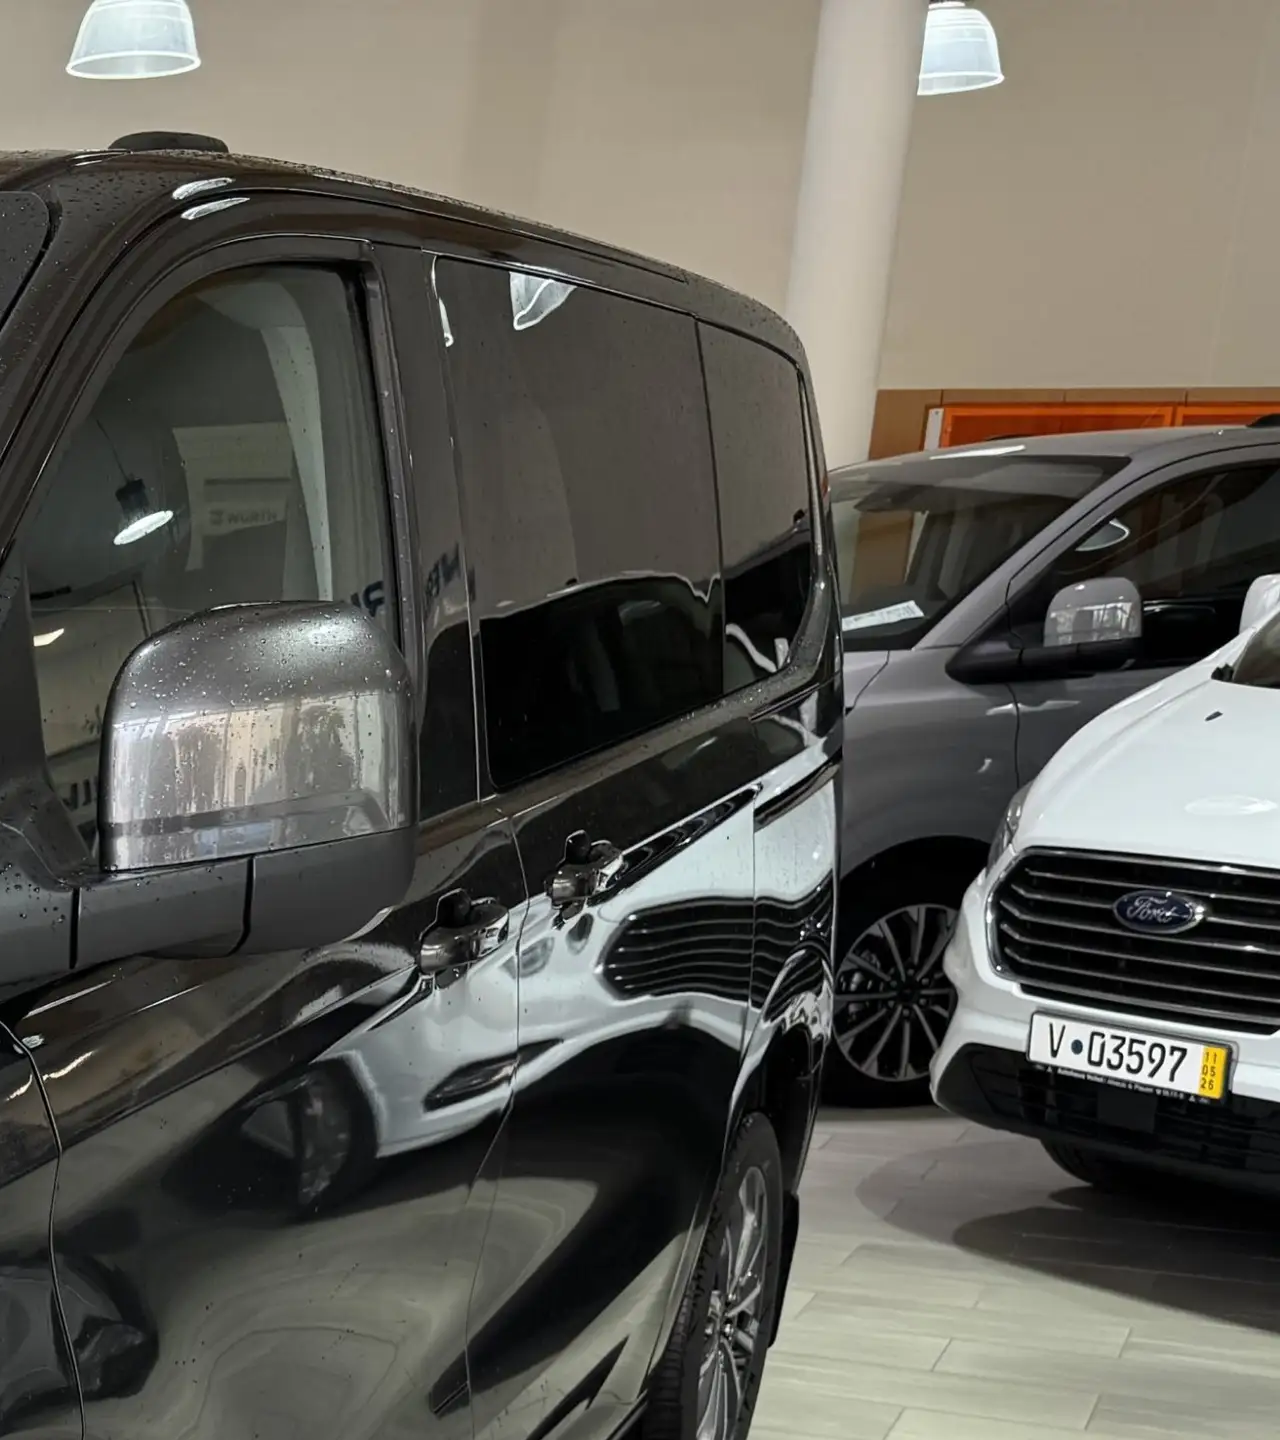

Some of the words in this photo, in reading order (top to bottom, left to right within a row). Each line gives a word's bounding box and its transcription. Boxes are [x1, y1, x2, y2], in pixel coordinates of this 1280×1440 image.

[1126, 896, 1178, 923] Ford
[1048, 1022, 1067, 1059] V
[1087, 1031, 1188, 1083] 03597
[1202, 1064, 1217, 1078] 05
[1200, 1077, 1215, 1091] 26
